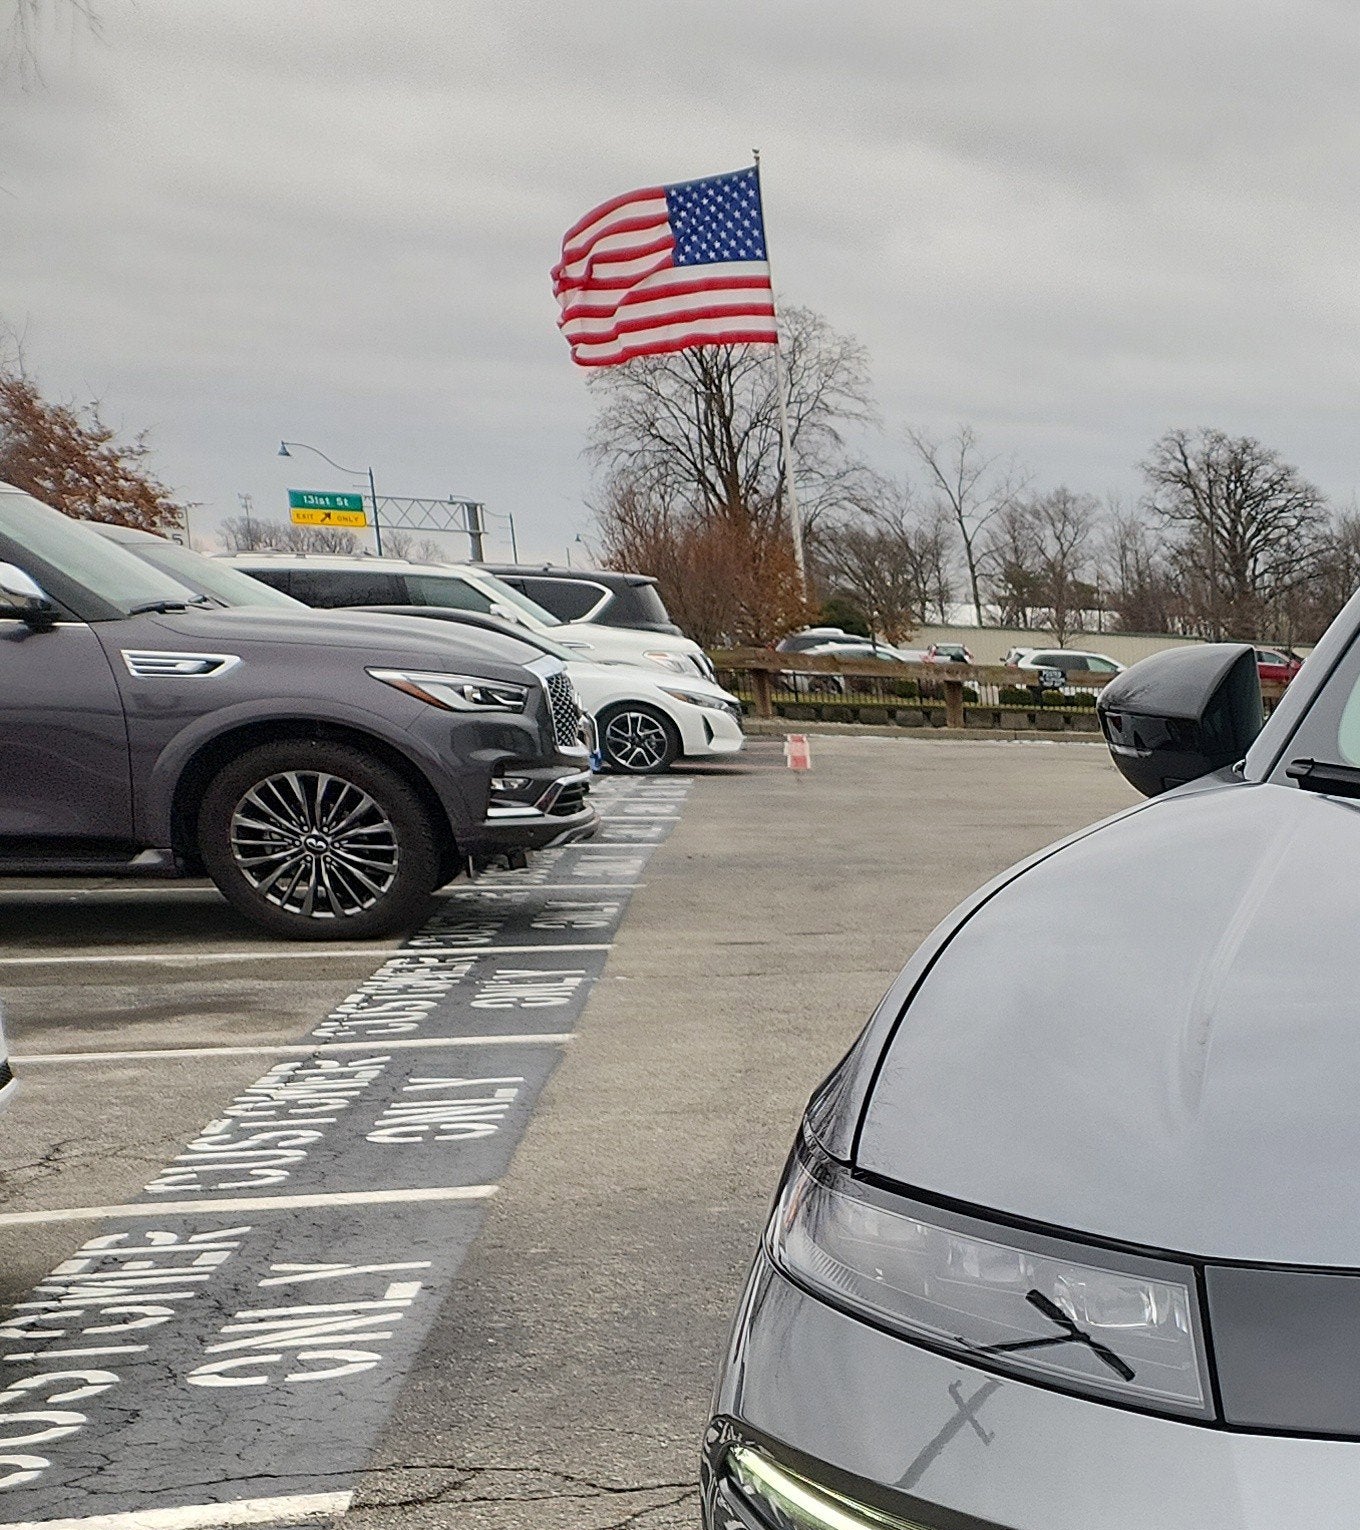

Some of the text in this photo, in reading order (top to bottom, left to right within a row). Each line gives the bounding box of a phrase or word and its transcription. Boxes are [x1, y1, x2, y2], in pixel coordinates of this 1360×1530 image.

[336, 496, 349, 506] St
[312, 955, 478, 1037] CUSTOMER
[470, 970, 586, 1009] ONLY
[144, 1055, 392, 1193] CUSTOMER
[366, 1076, 525, 1143] ONLY
[187, 1260, 432, 1387] ONLY
